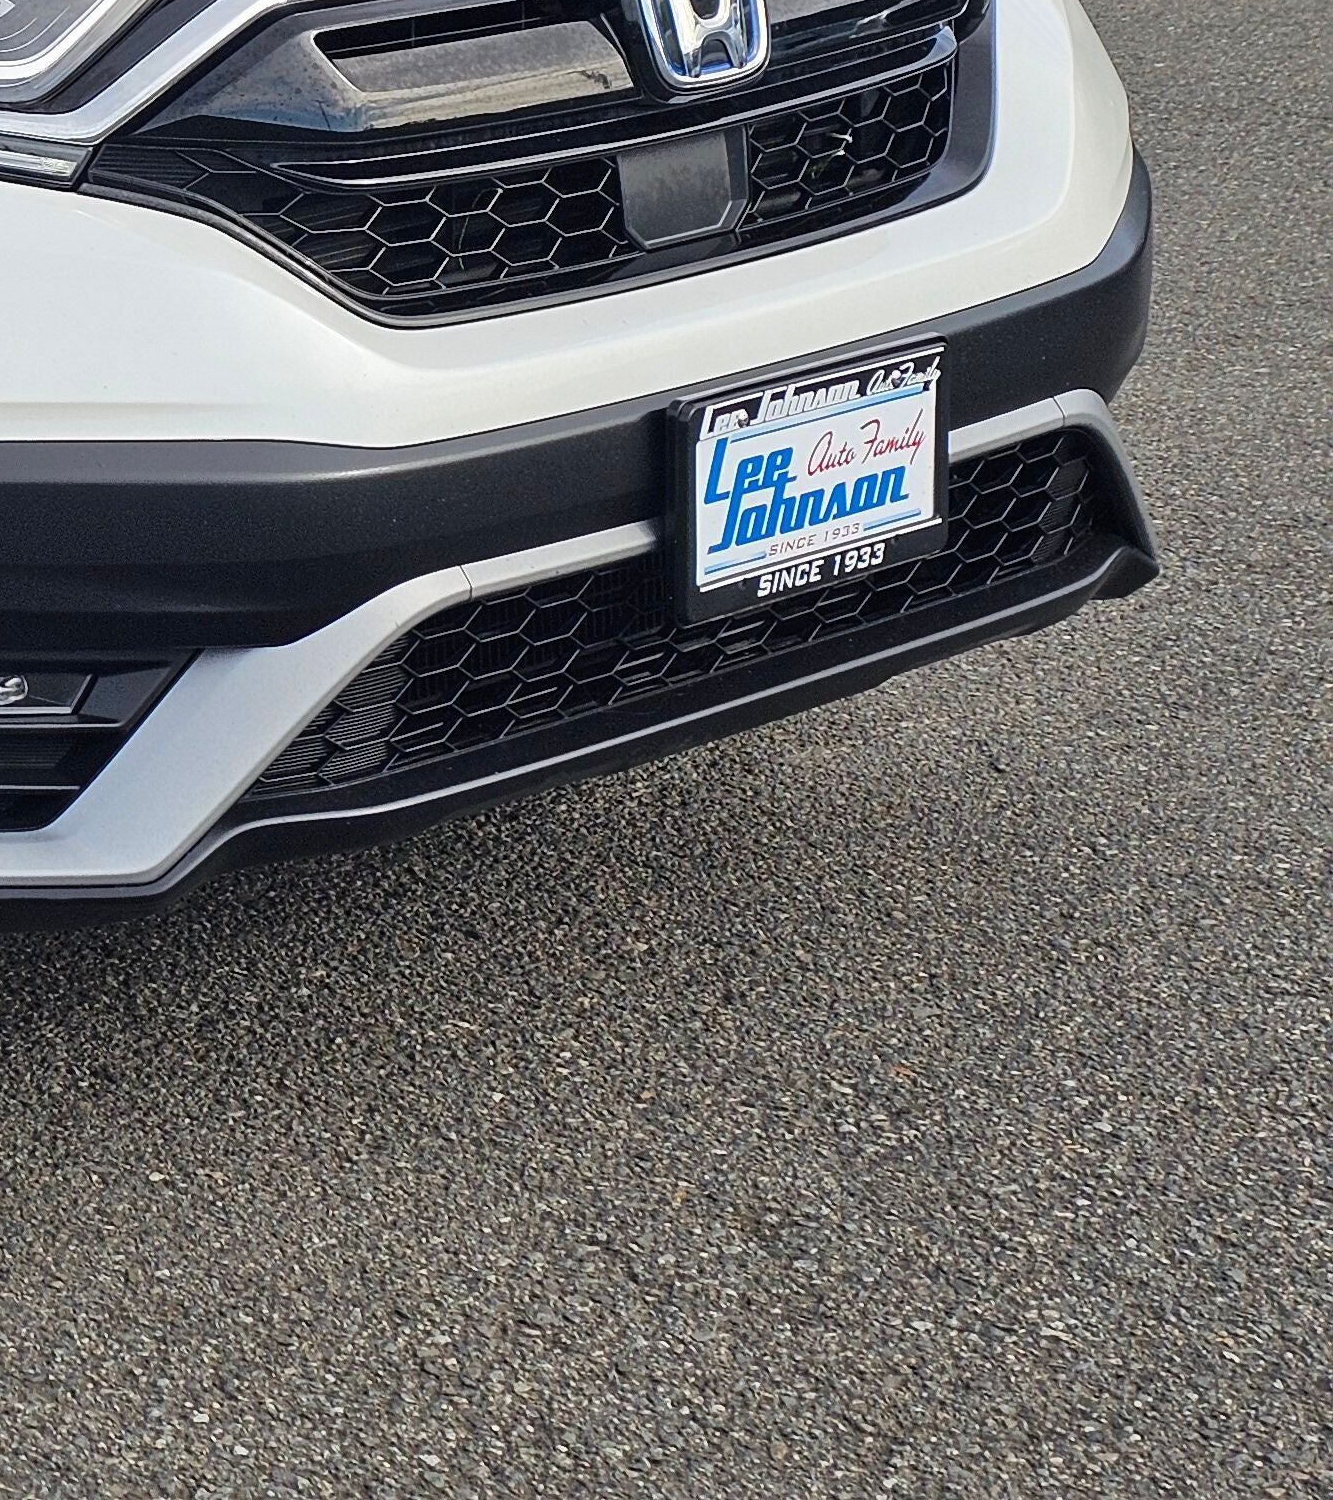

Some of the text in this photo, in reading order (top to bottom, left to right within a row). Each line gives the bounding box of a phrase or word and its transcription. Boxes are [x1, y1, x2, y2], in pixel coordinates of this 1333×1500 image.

[750, 380, 861, 425] Johnson
[704, 437, 797, 505] Lee
[807, 408, 925, 476] Auto Family
[707, 466, 909, 555] Johnson
[768, 522, 861, 557] SINCE 1933
[757, 543, 885, 598] SINCE 1933
